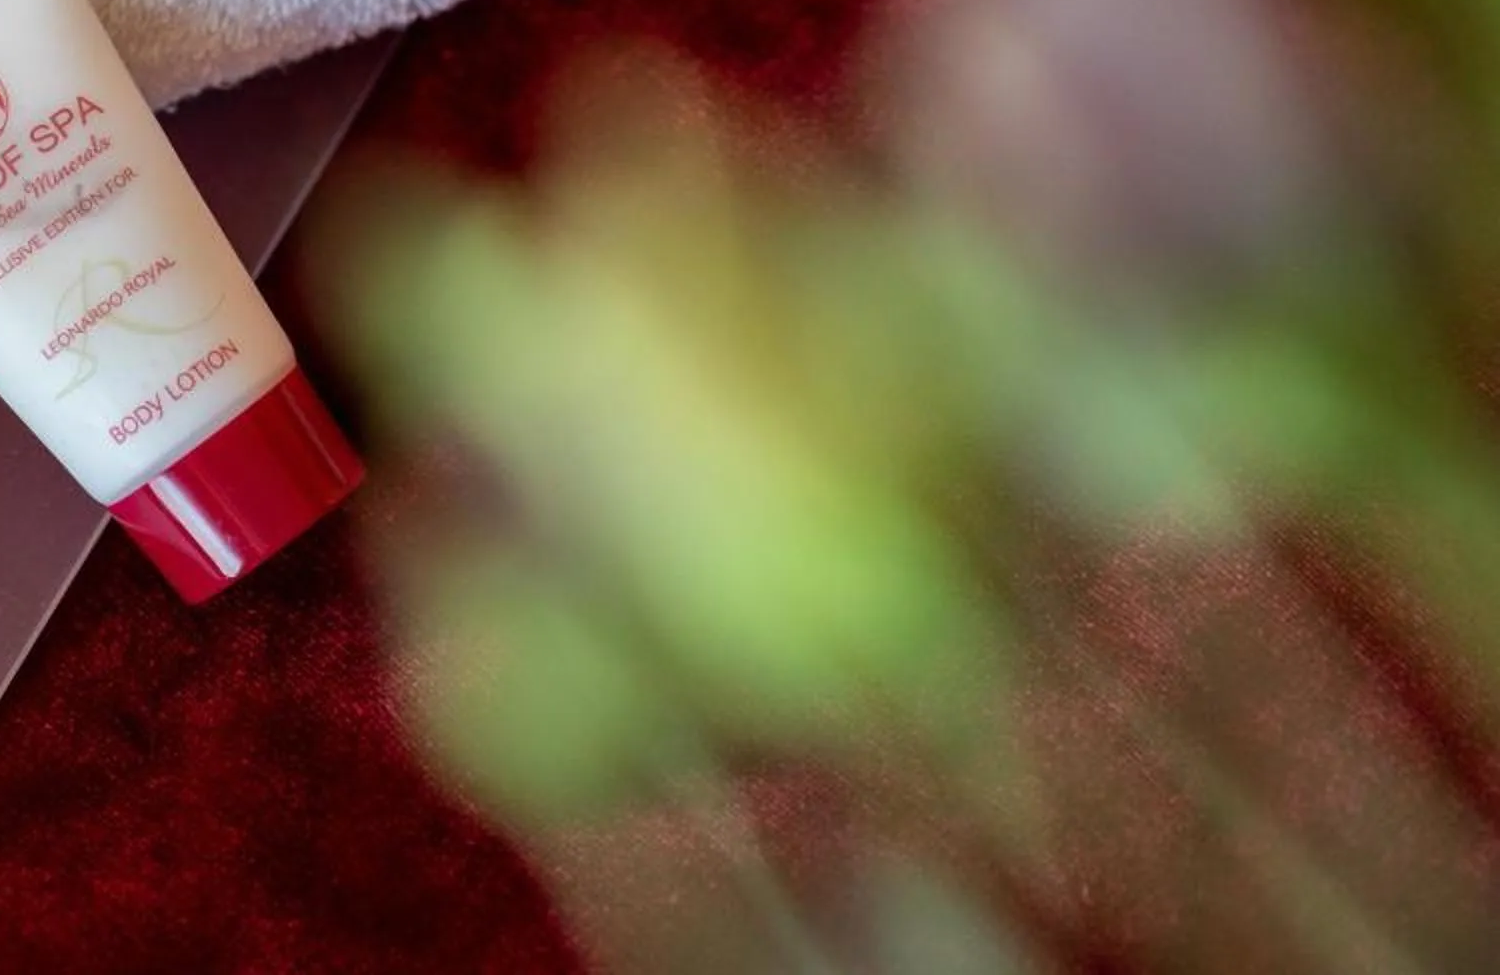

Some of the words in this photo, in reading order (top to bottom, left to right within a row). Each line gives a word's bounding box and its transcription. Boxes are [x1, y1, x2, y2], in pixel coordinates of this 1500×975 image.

[30, 96, 105, 153] SPA
[24, 134, 112, 200] Minerals
[45, 191, 105, 241] EDITION
[104, 166, 139, 196] FOR
[41, 291, 124, 361] LEONARDO
[123, 256, 176, 296] ROYAL
[108, 391, 164, 445] BODY
[164, 338, 240, 401] LOTION
